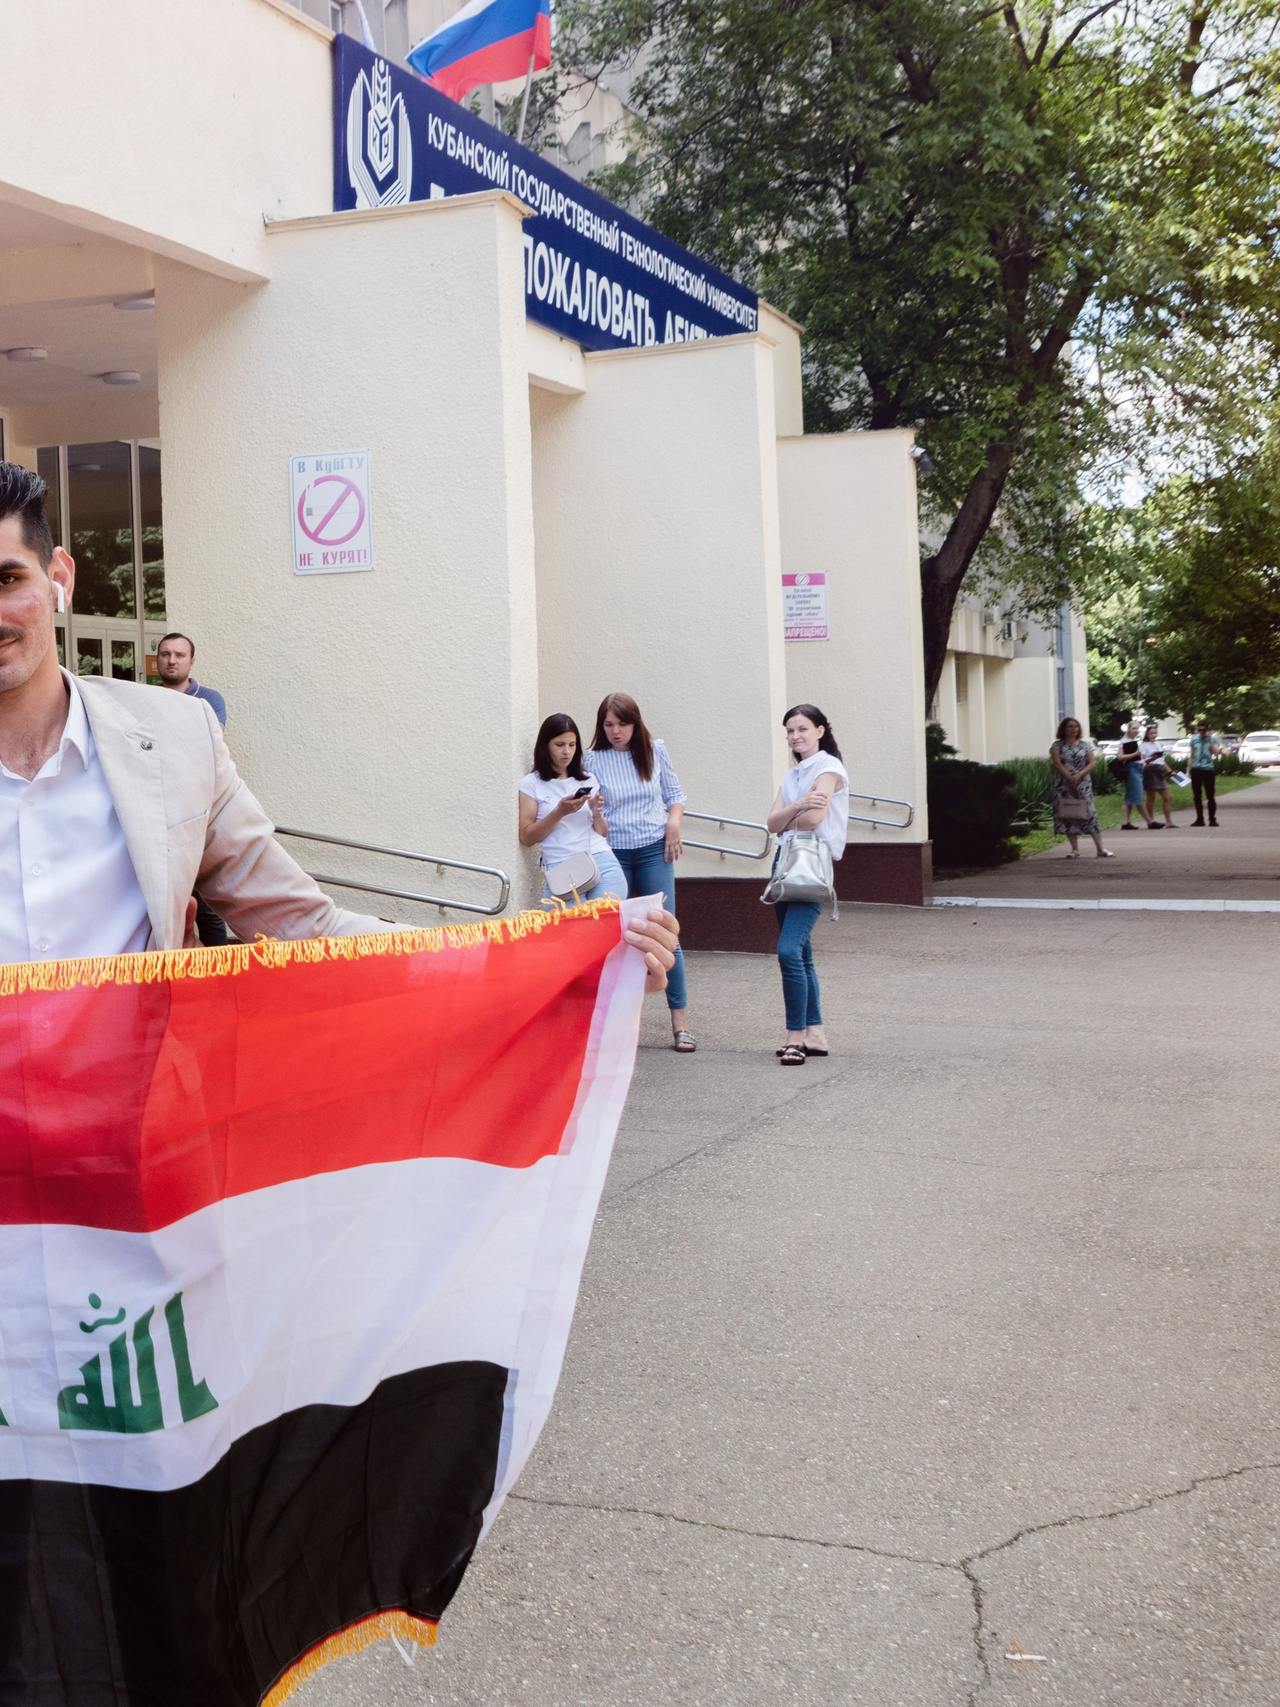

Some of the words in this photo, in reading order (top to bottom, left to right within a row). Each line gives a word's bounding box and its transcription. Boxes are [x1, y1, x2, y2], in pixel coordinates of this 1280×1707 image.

[428, 112, 510, 190] КУБАНСКИЙ
[511, 164, 620, 255] ГОСУДАРСТВЕННЫЙ
[620, 230, 707, 304] ТЕХНОЛОГИЧЕСКИЙ
[706, 282, 757, 332] УНИВЕРСИТЕТ
[297, 460, 306, 474] В
[315, 456, 365, 474] КубГТУ
[299, 552, 315, 567] НЕ
[322, 549, 368, 566] КУРЯТ!
[57, 1292, 219, 1434] الله
